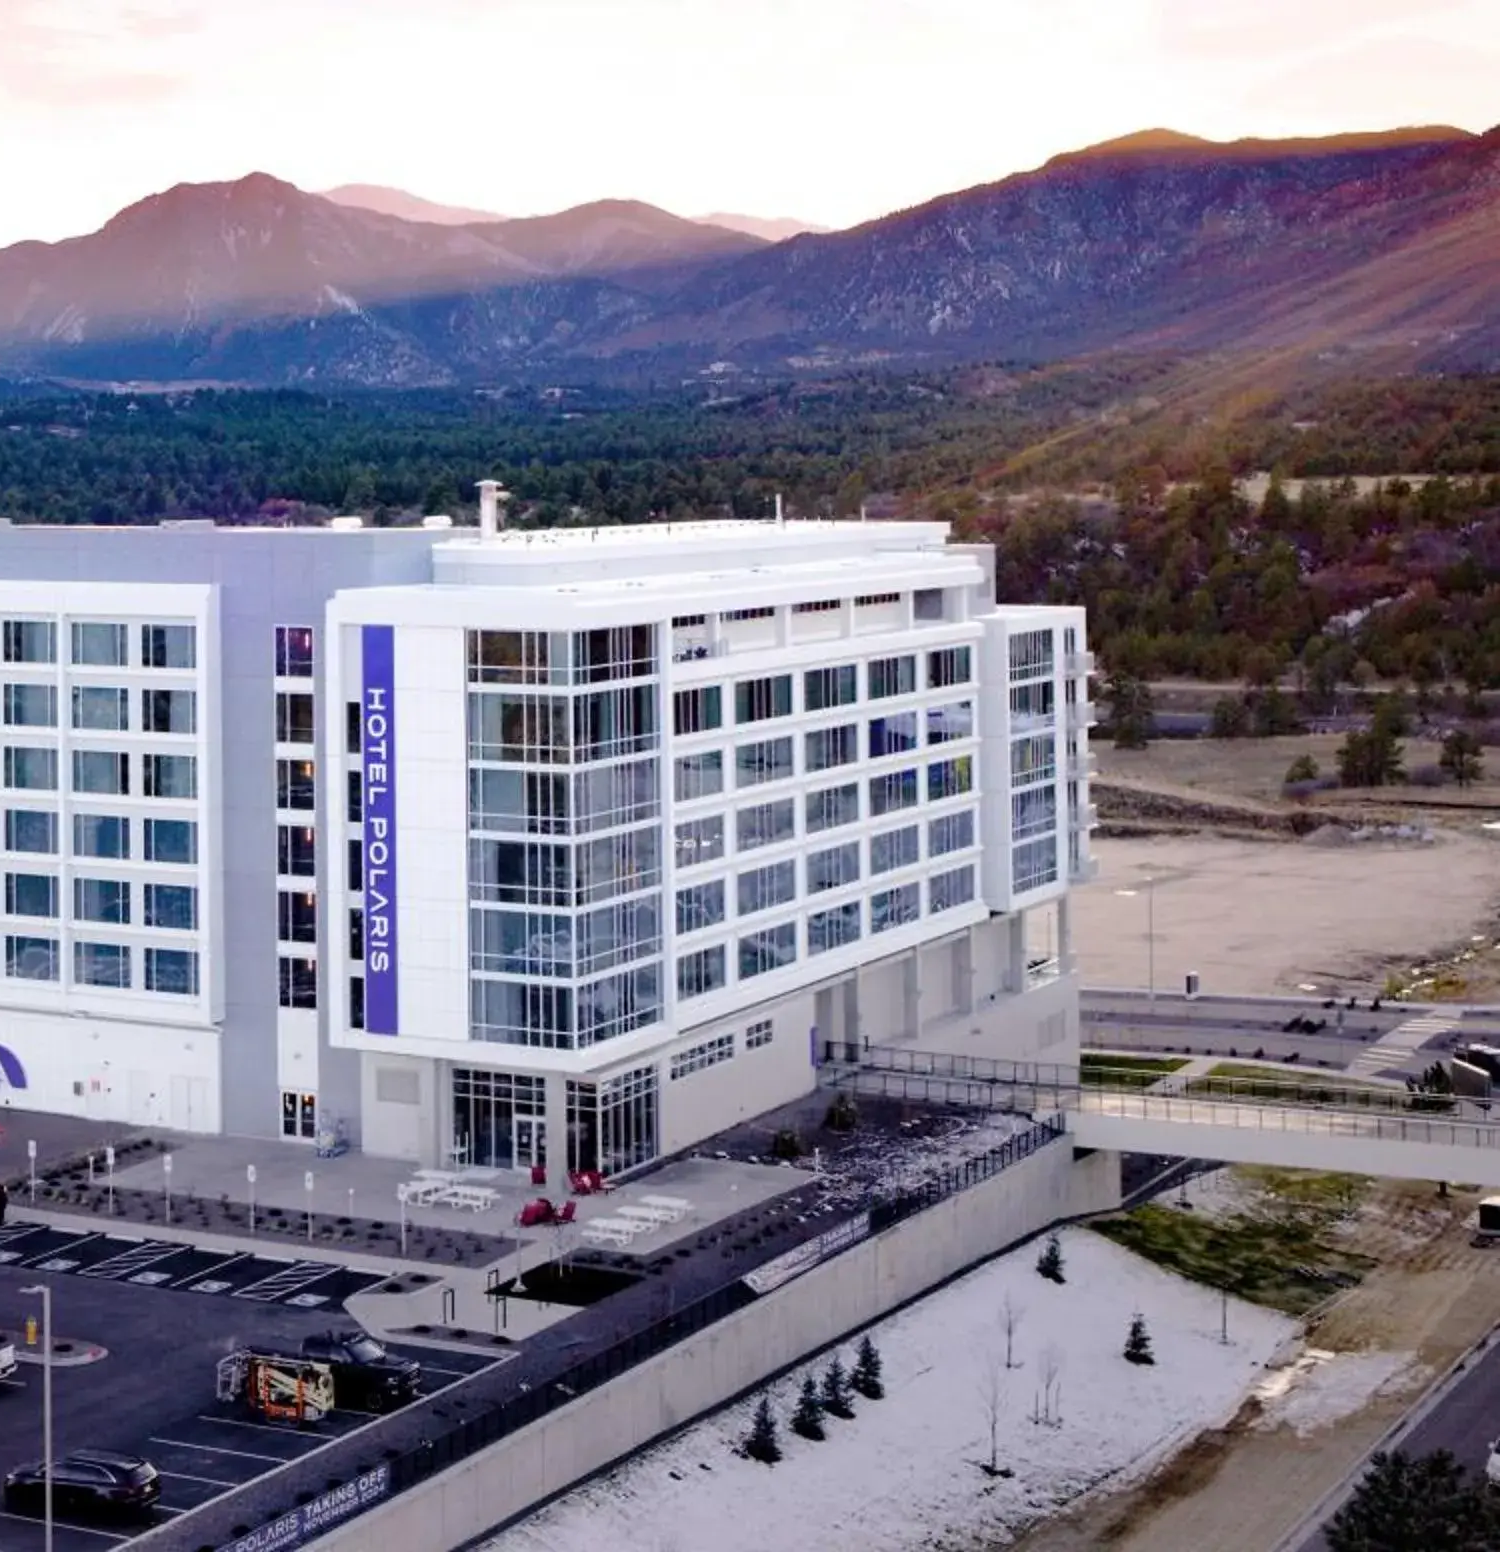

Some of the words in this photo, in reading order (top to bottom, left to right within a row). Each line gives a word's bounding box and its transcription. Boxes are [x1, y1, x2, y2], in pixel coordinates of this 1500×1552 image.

[367, 688, 387, 805] HOTEL
[368, 817, 389, 973] POLARIS
[235, 1513, 298, 1552] POLARIS
[303, 1482, 357, 1518] TAKING
[359, 1467, 387, 1491] OFF
